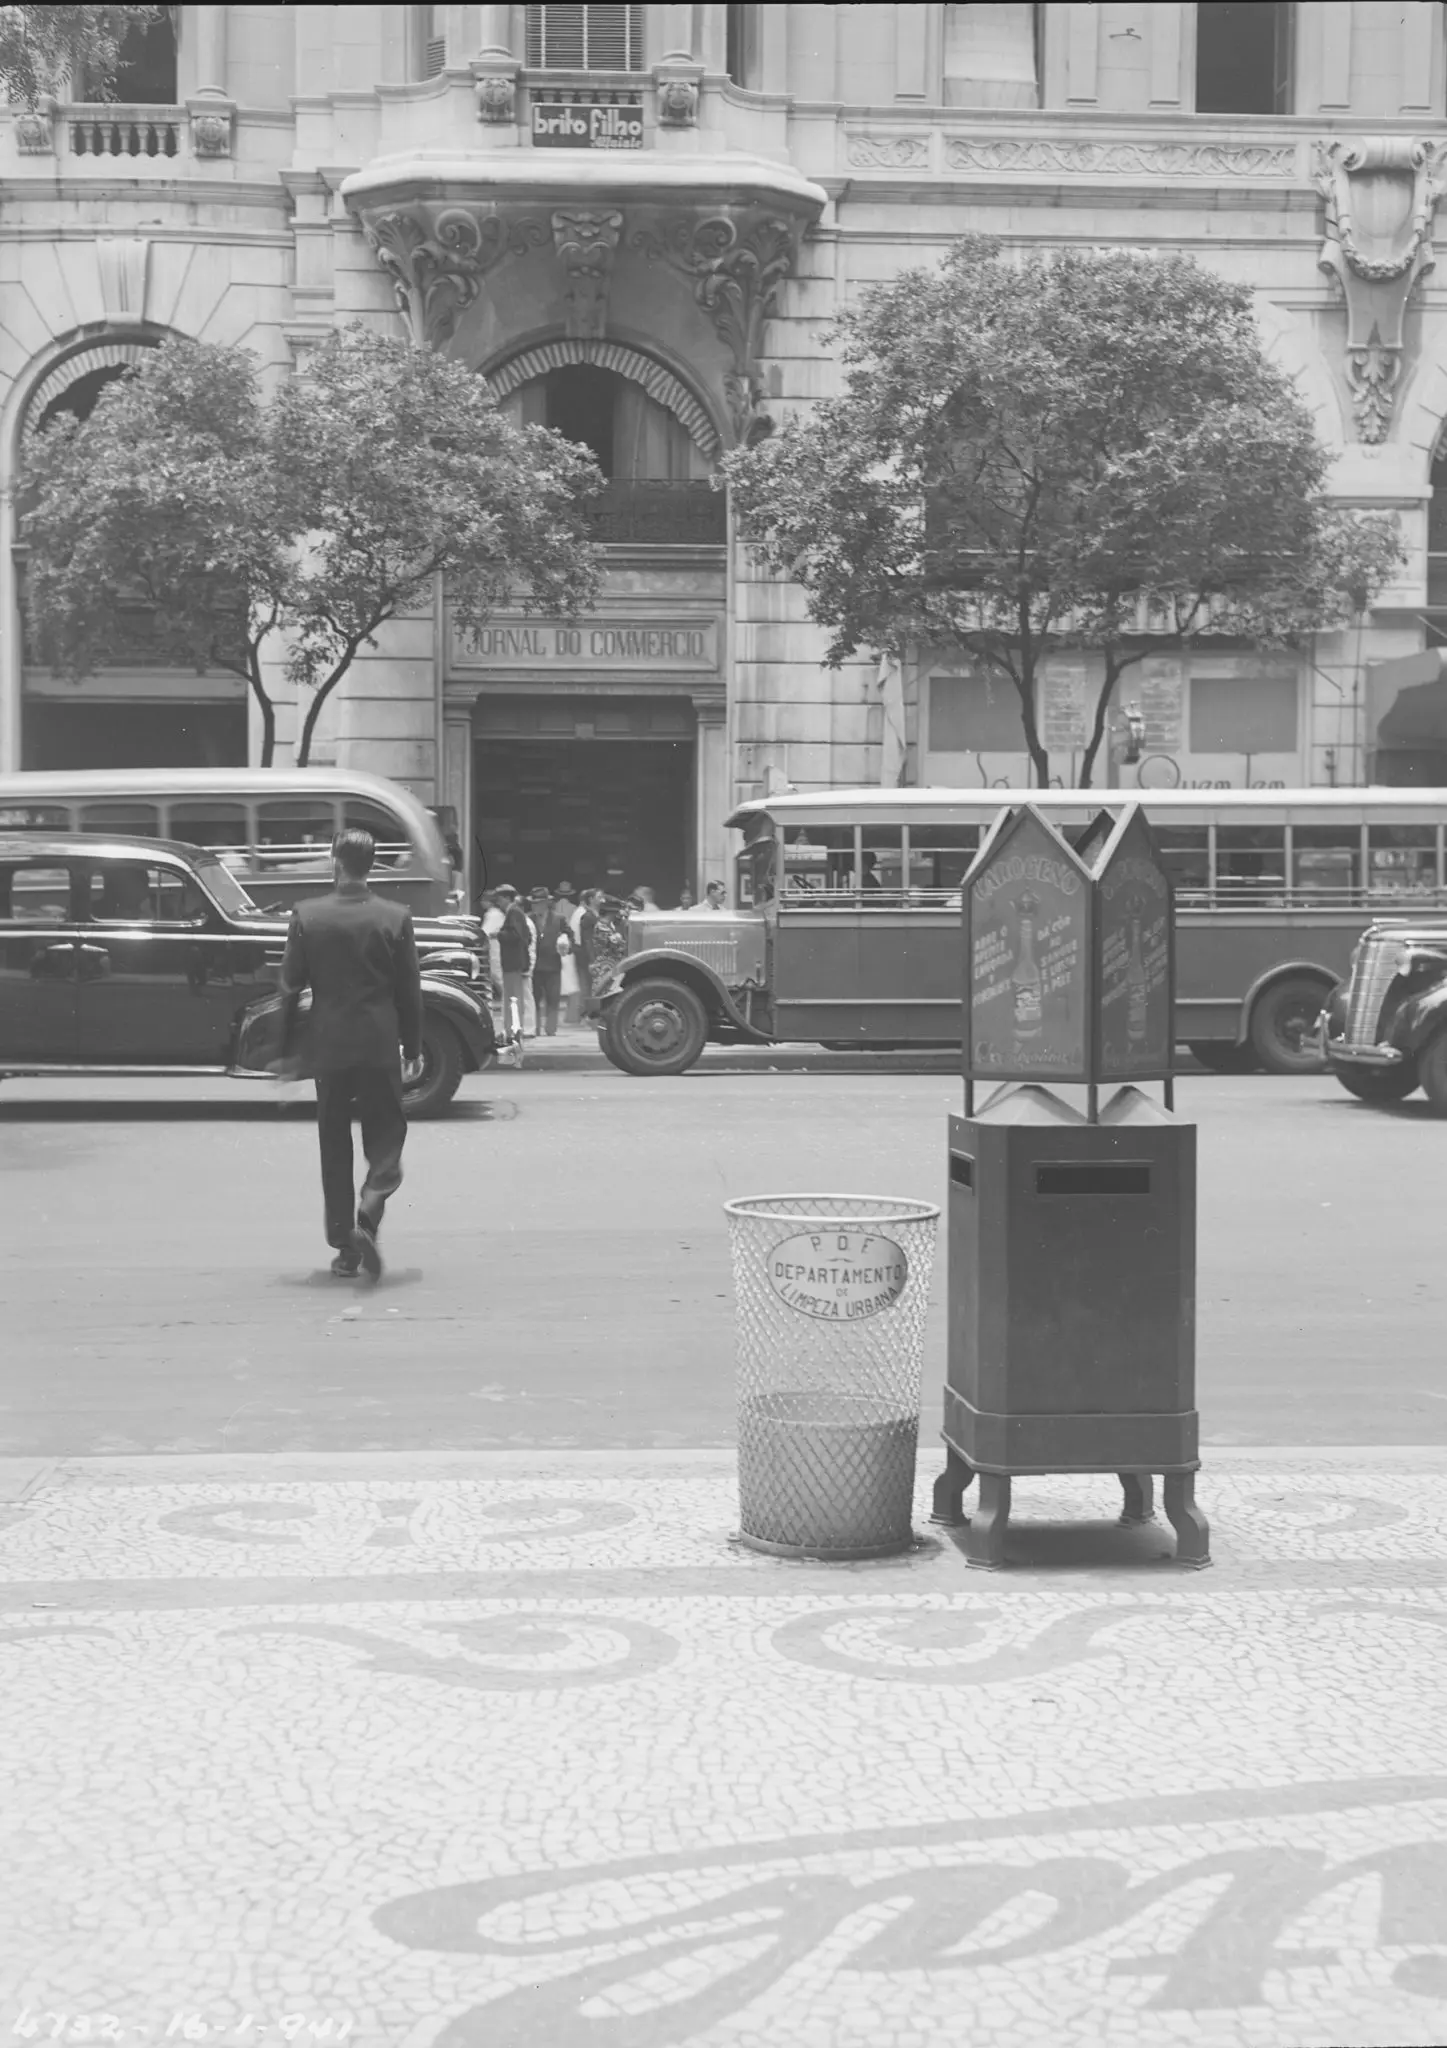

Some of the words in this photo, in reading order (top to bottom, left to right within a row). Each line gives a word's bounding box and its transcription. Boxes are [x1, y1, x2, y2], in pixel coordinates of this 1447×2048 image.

[534, 106, 588, 135] brito
[590, 108, 643, 140] filho
[465, 628, 547, 656] JORNAL
[555, 630, 583, 656] DO
[590, 630, 705, 658] COMMERCIO
[775, 1261, 901, 1285] DEPARTAMENTO
[780, 1282, 840, 1317] LIMPEZA
[845, 1286, 898, 1318] URBANA
